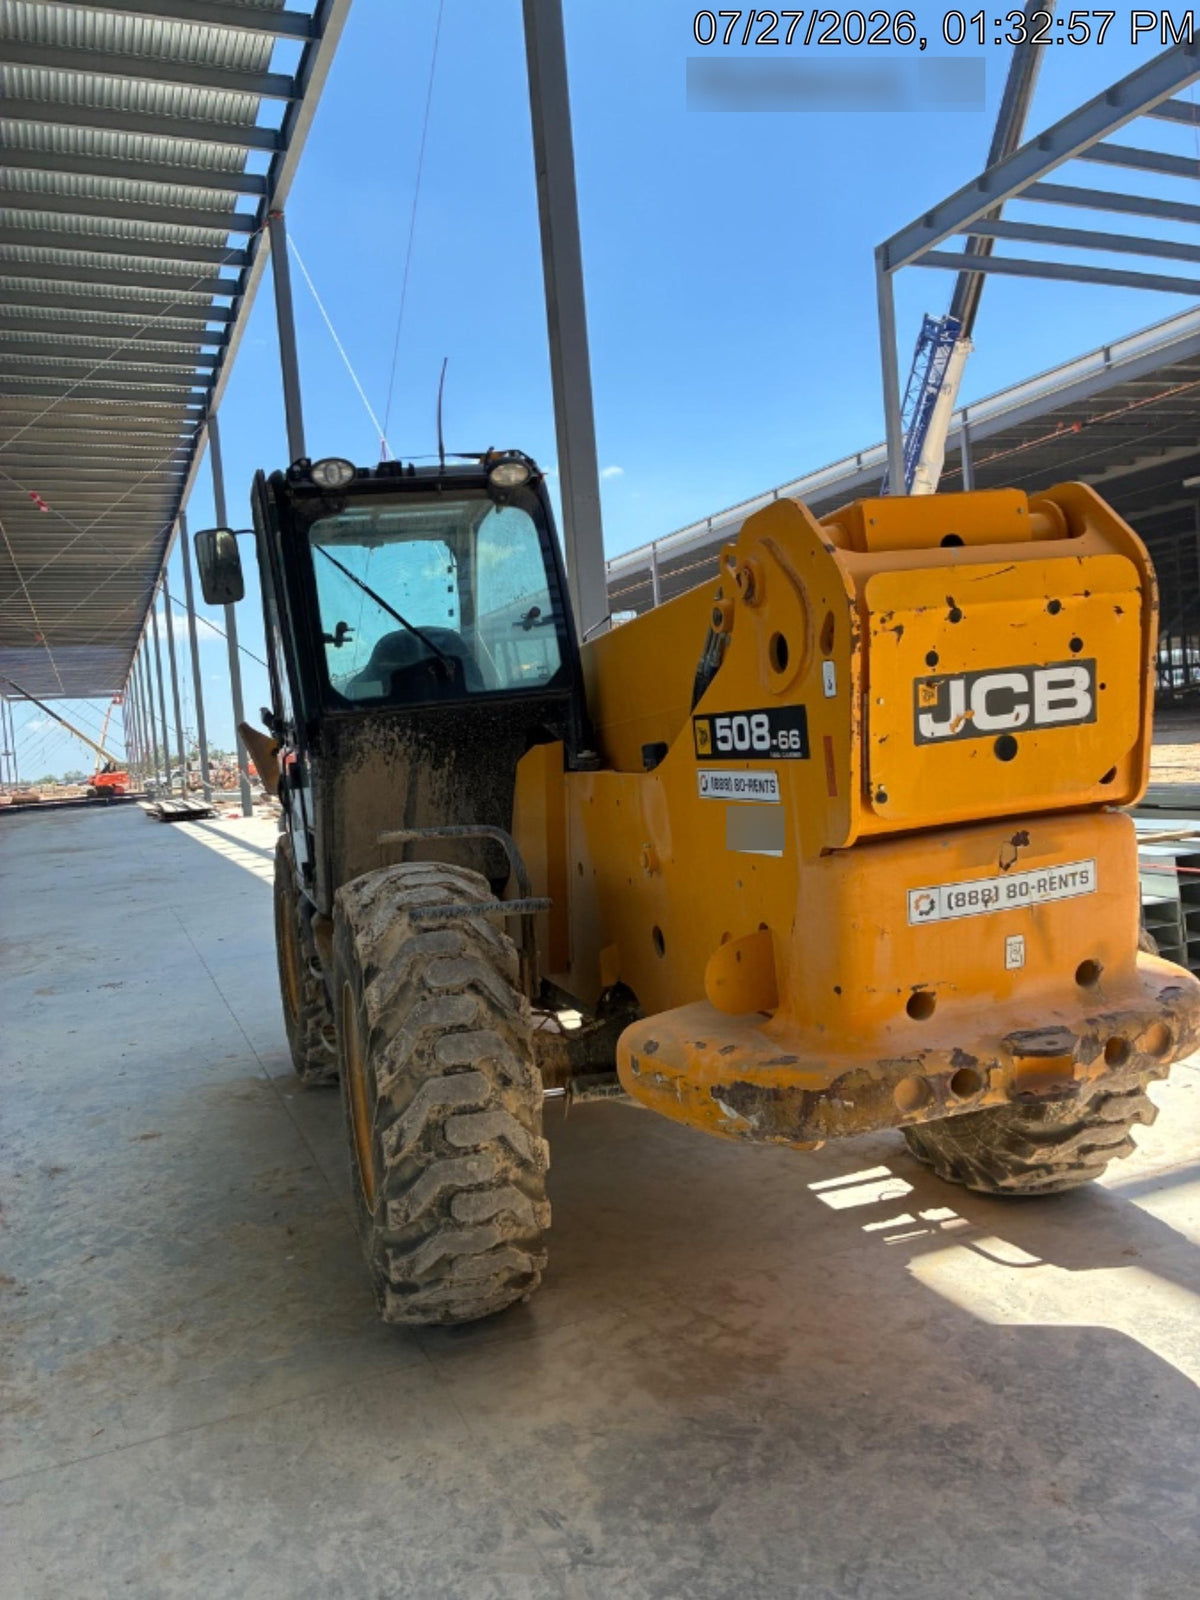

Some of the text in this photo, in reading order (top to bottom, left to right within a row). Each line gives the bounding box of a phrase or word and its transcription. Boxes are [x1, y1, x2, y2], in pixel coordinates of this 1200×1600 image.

[918, 666, 1092, 738] JCB
[947, 870, 1089, 911] (888) 80-RENTS
